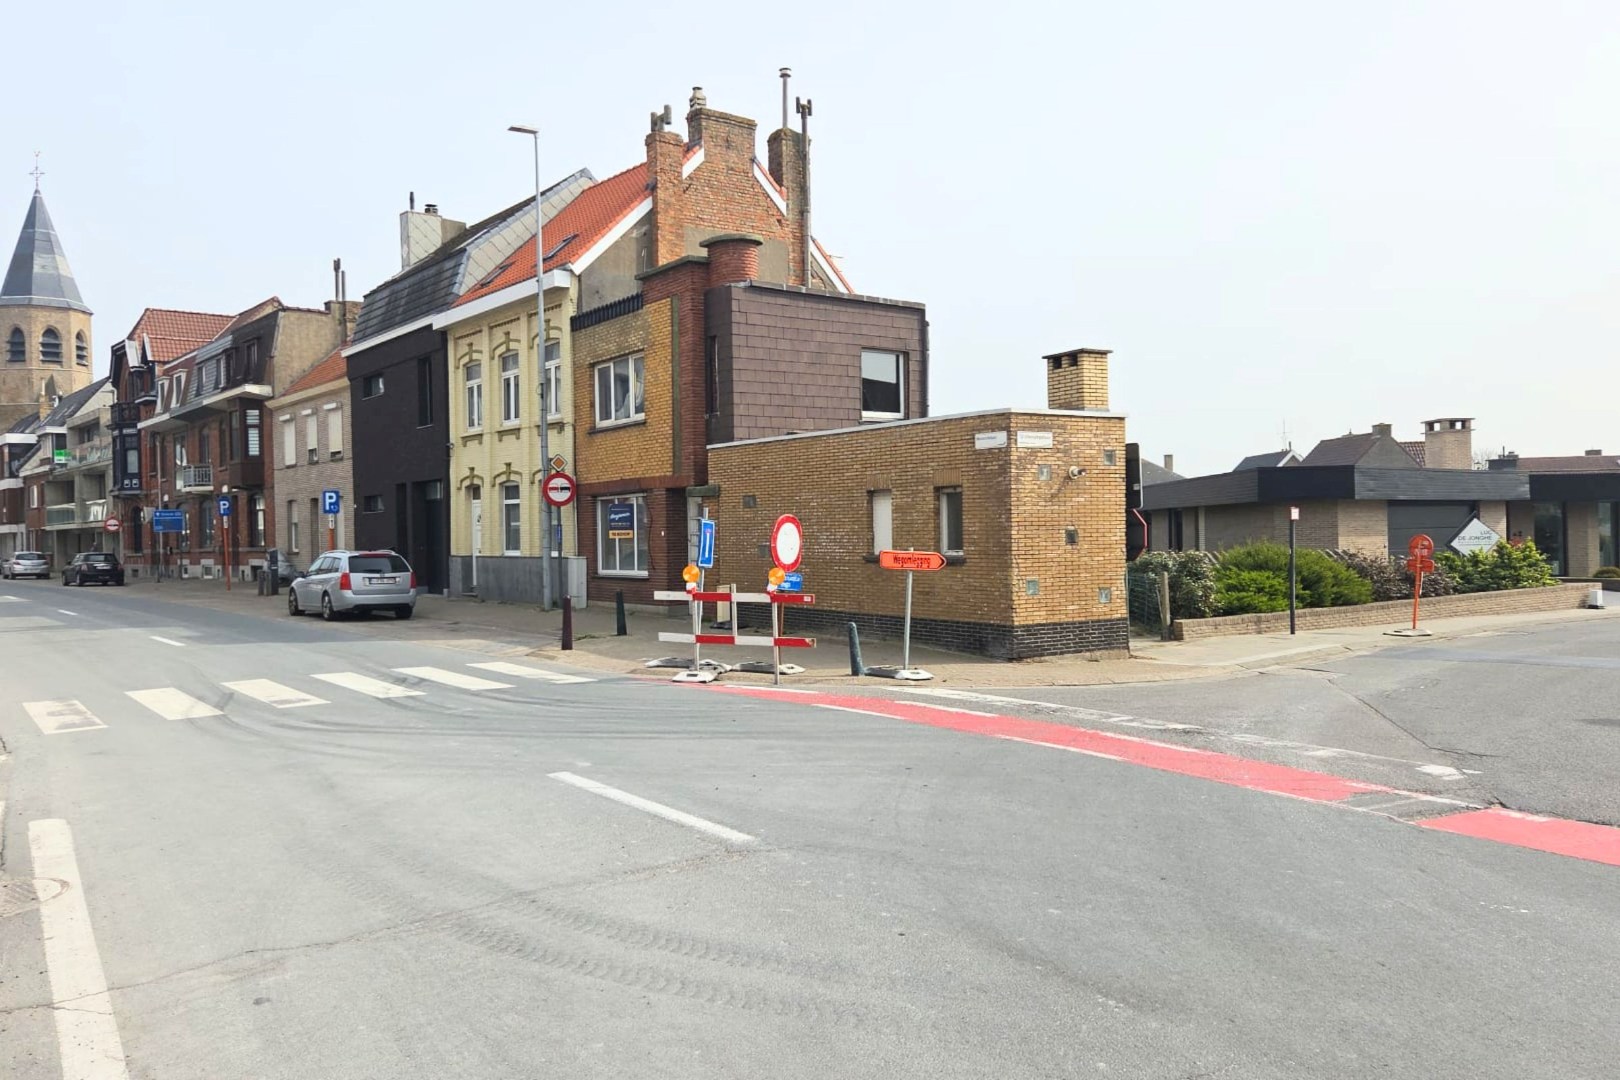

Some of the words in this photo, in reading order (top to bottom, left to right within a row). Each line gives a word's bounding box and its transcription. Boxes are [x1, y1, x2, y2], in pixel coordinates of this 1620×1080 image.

[219, 501, 229, 514] P
[325, 492, 336, 510] P
[893, 554, 931, 568] Wegomlegging
